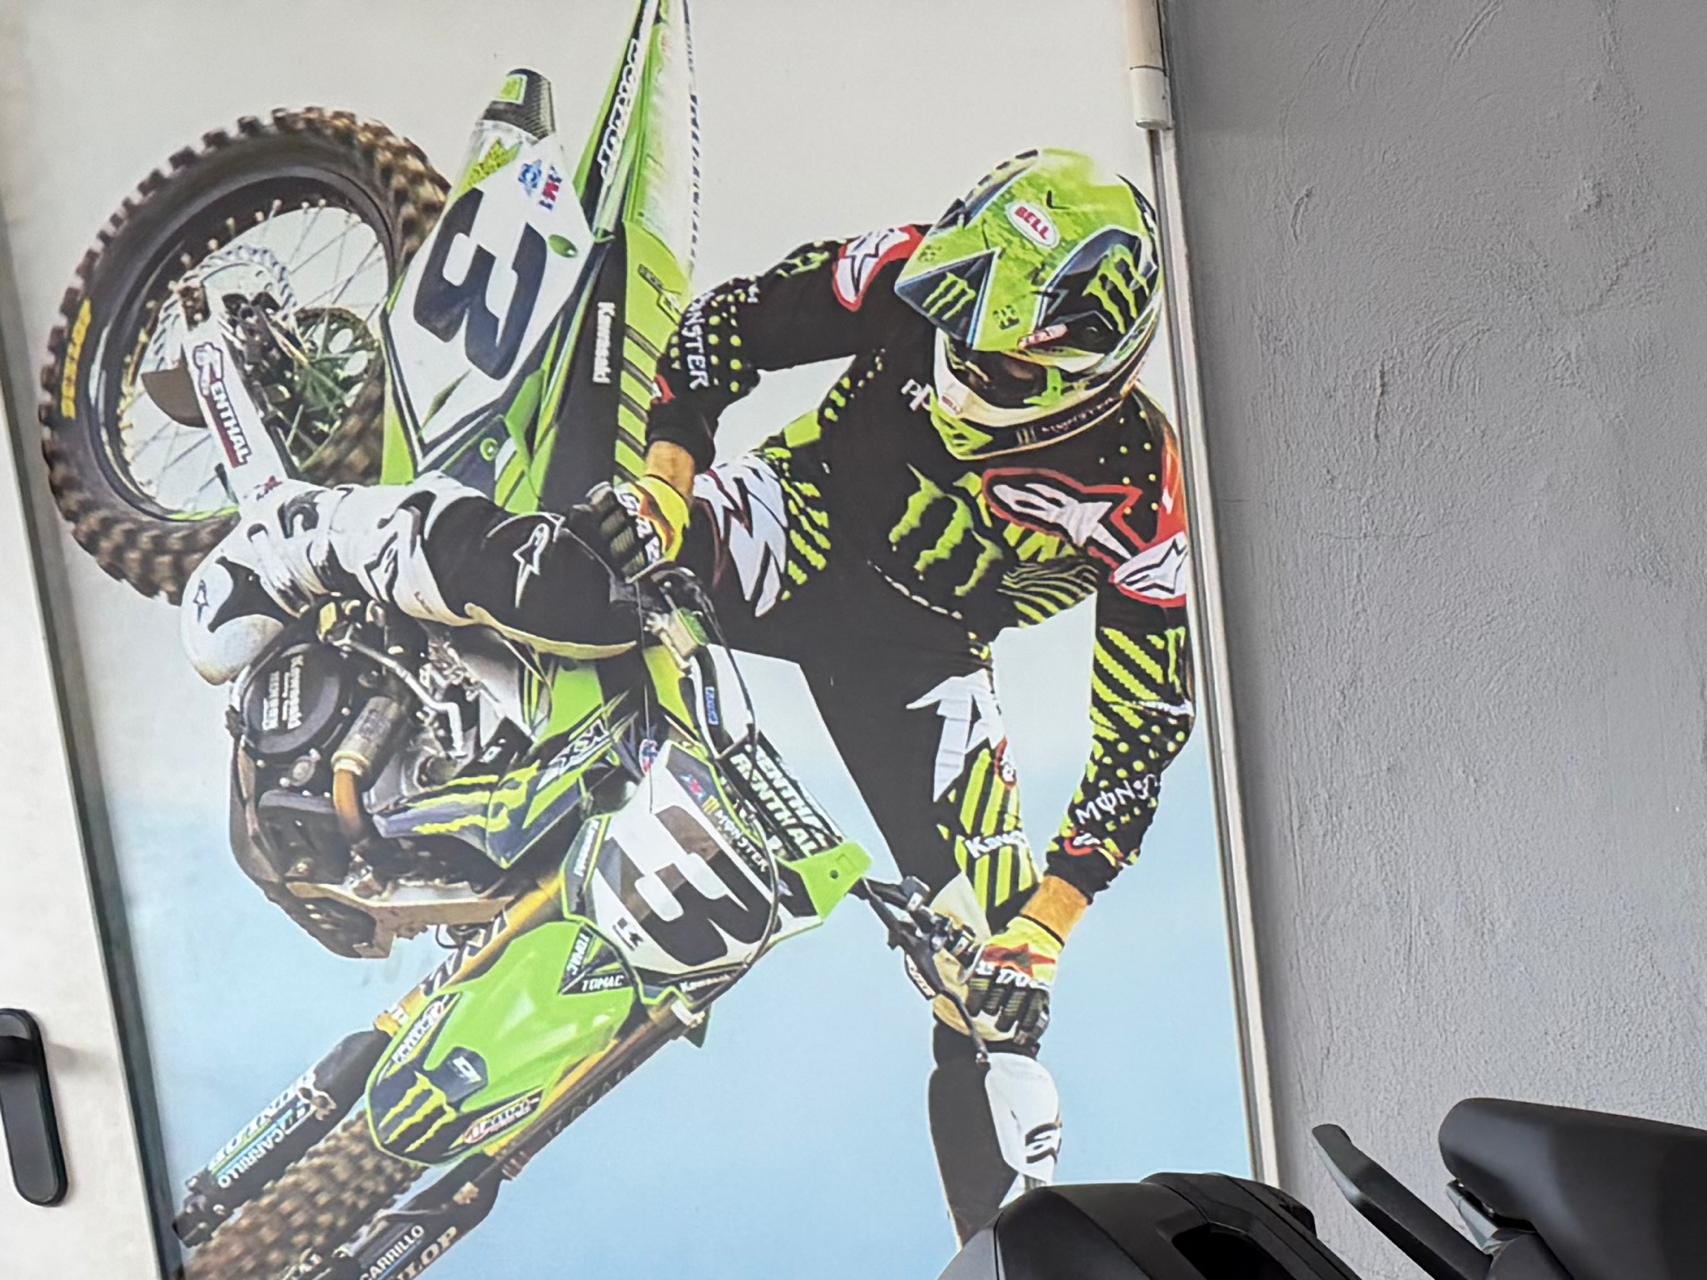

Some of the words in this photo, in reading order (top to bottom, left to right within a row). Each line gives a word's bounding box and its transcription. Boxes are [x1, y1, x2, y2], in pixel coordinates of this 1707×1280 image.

[1013, 205, 1051, 241] BELL
[413, 186, 548, 381] 3
[730, 753, 817, 858] RENTHAL
[582, 974, 624, 993] TOMAC
[218, 1128, 286, 1189] CARRILLO
